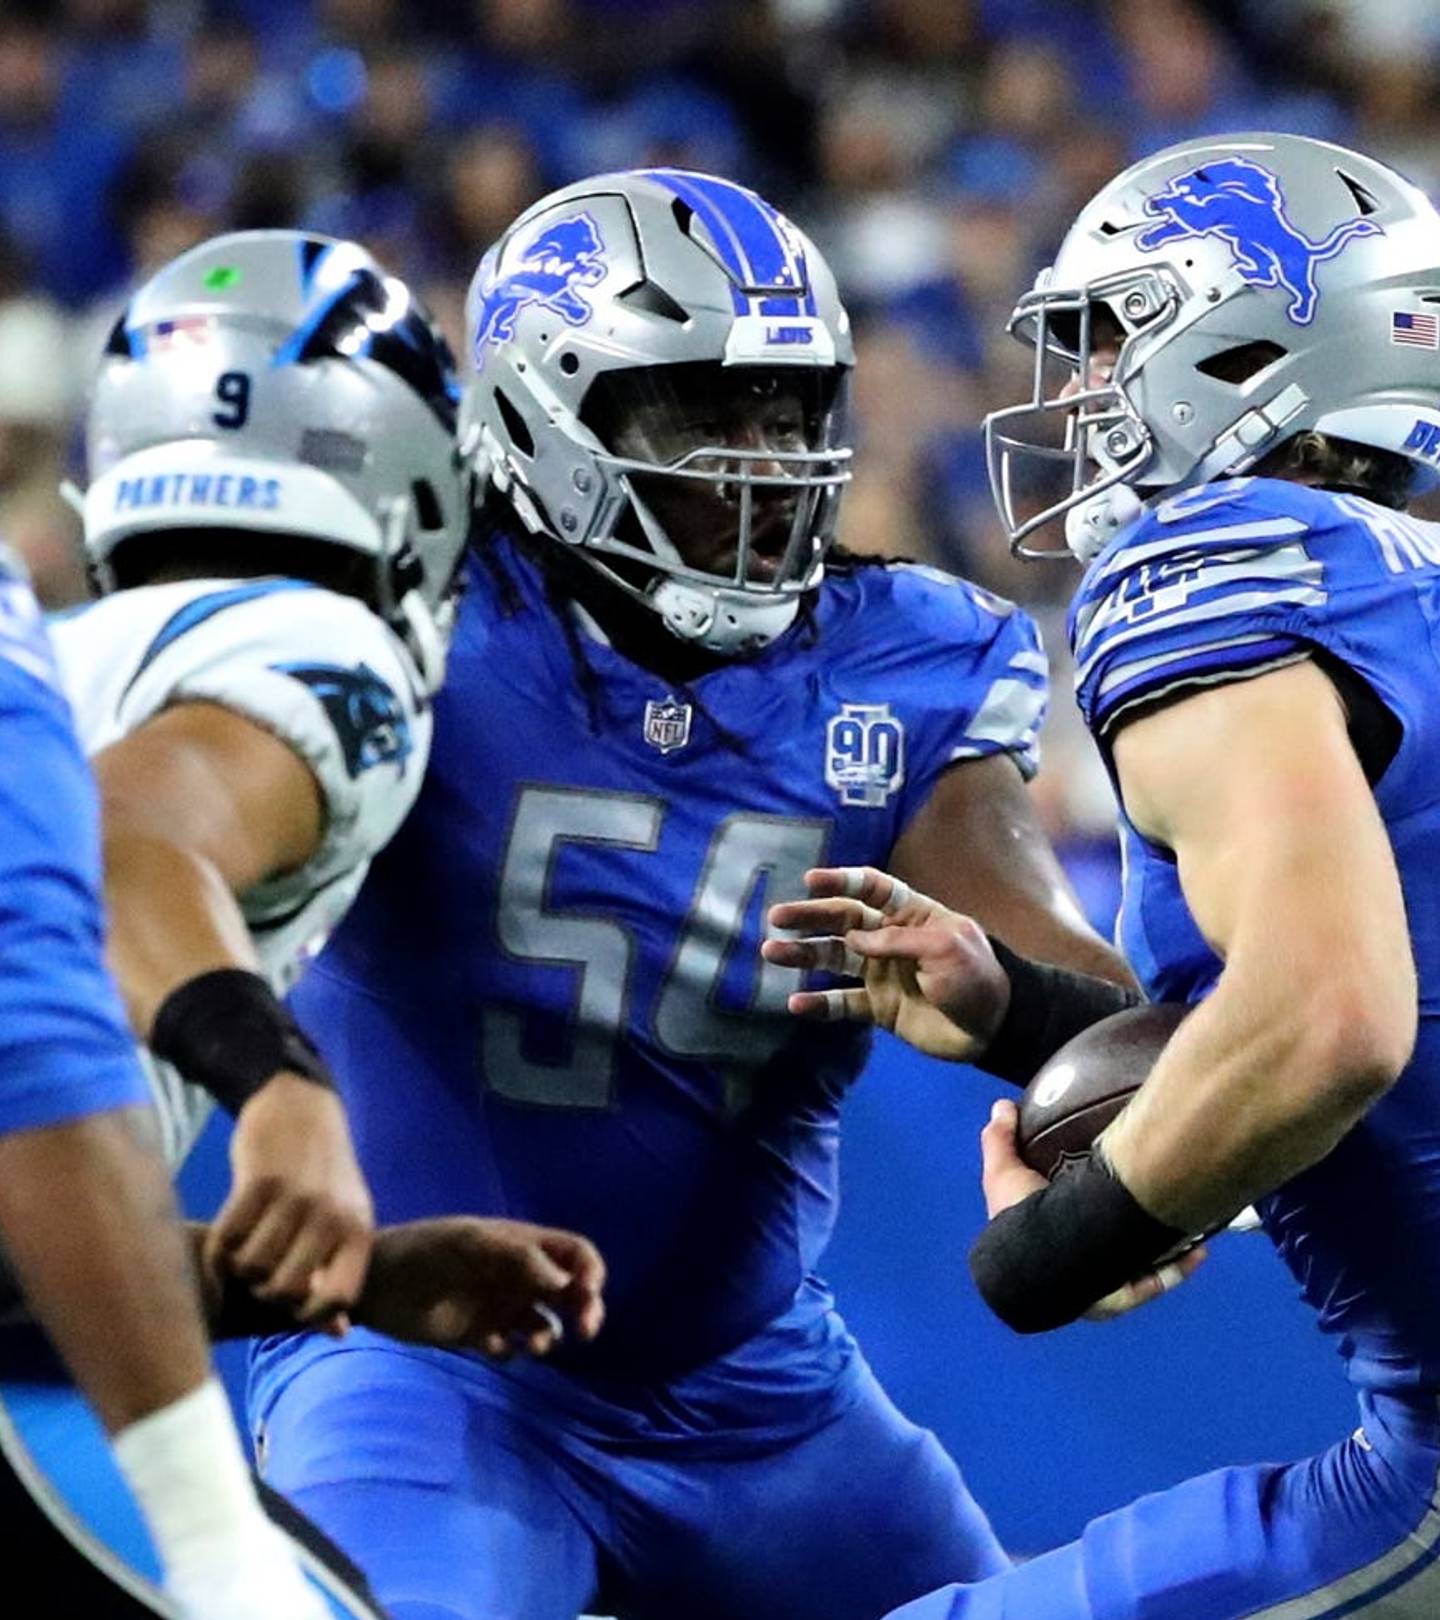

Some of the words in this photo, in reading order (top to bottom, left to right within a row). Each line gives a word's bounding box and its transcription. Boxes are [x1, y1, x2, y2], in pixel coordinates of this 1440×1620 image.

[213, 375, 250, 431] 9
[114, 473, 281, 513] PANTHERS
[832, 719, 900, 780] 90
[480, 783, 838, 1116] 54
